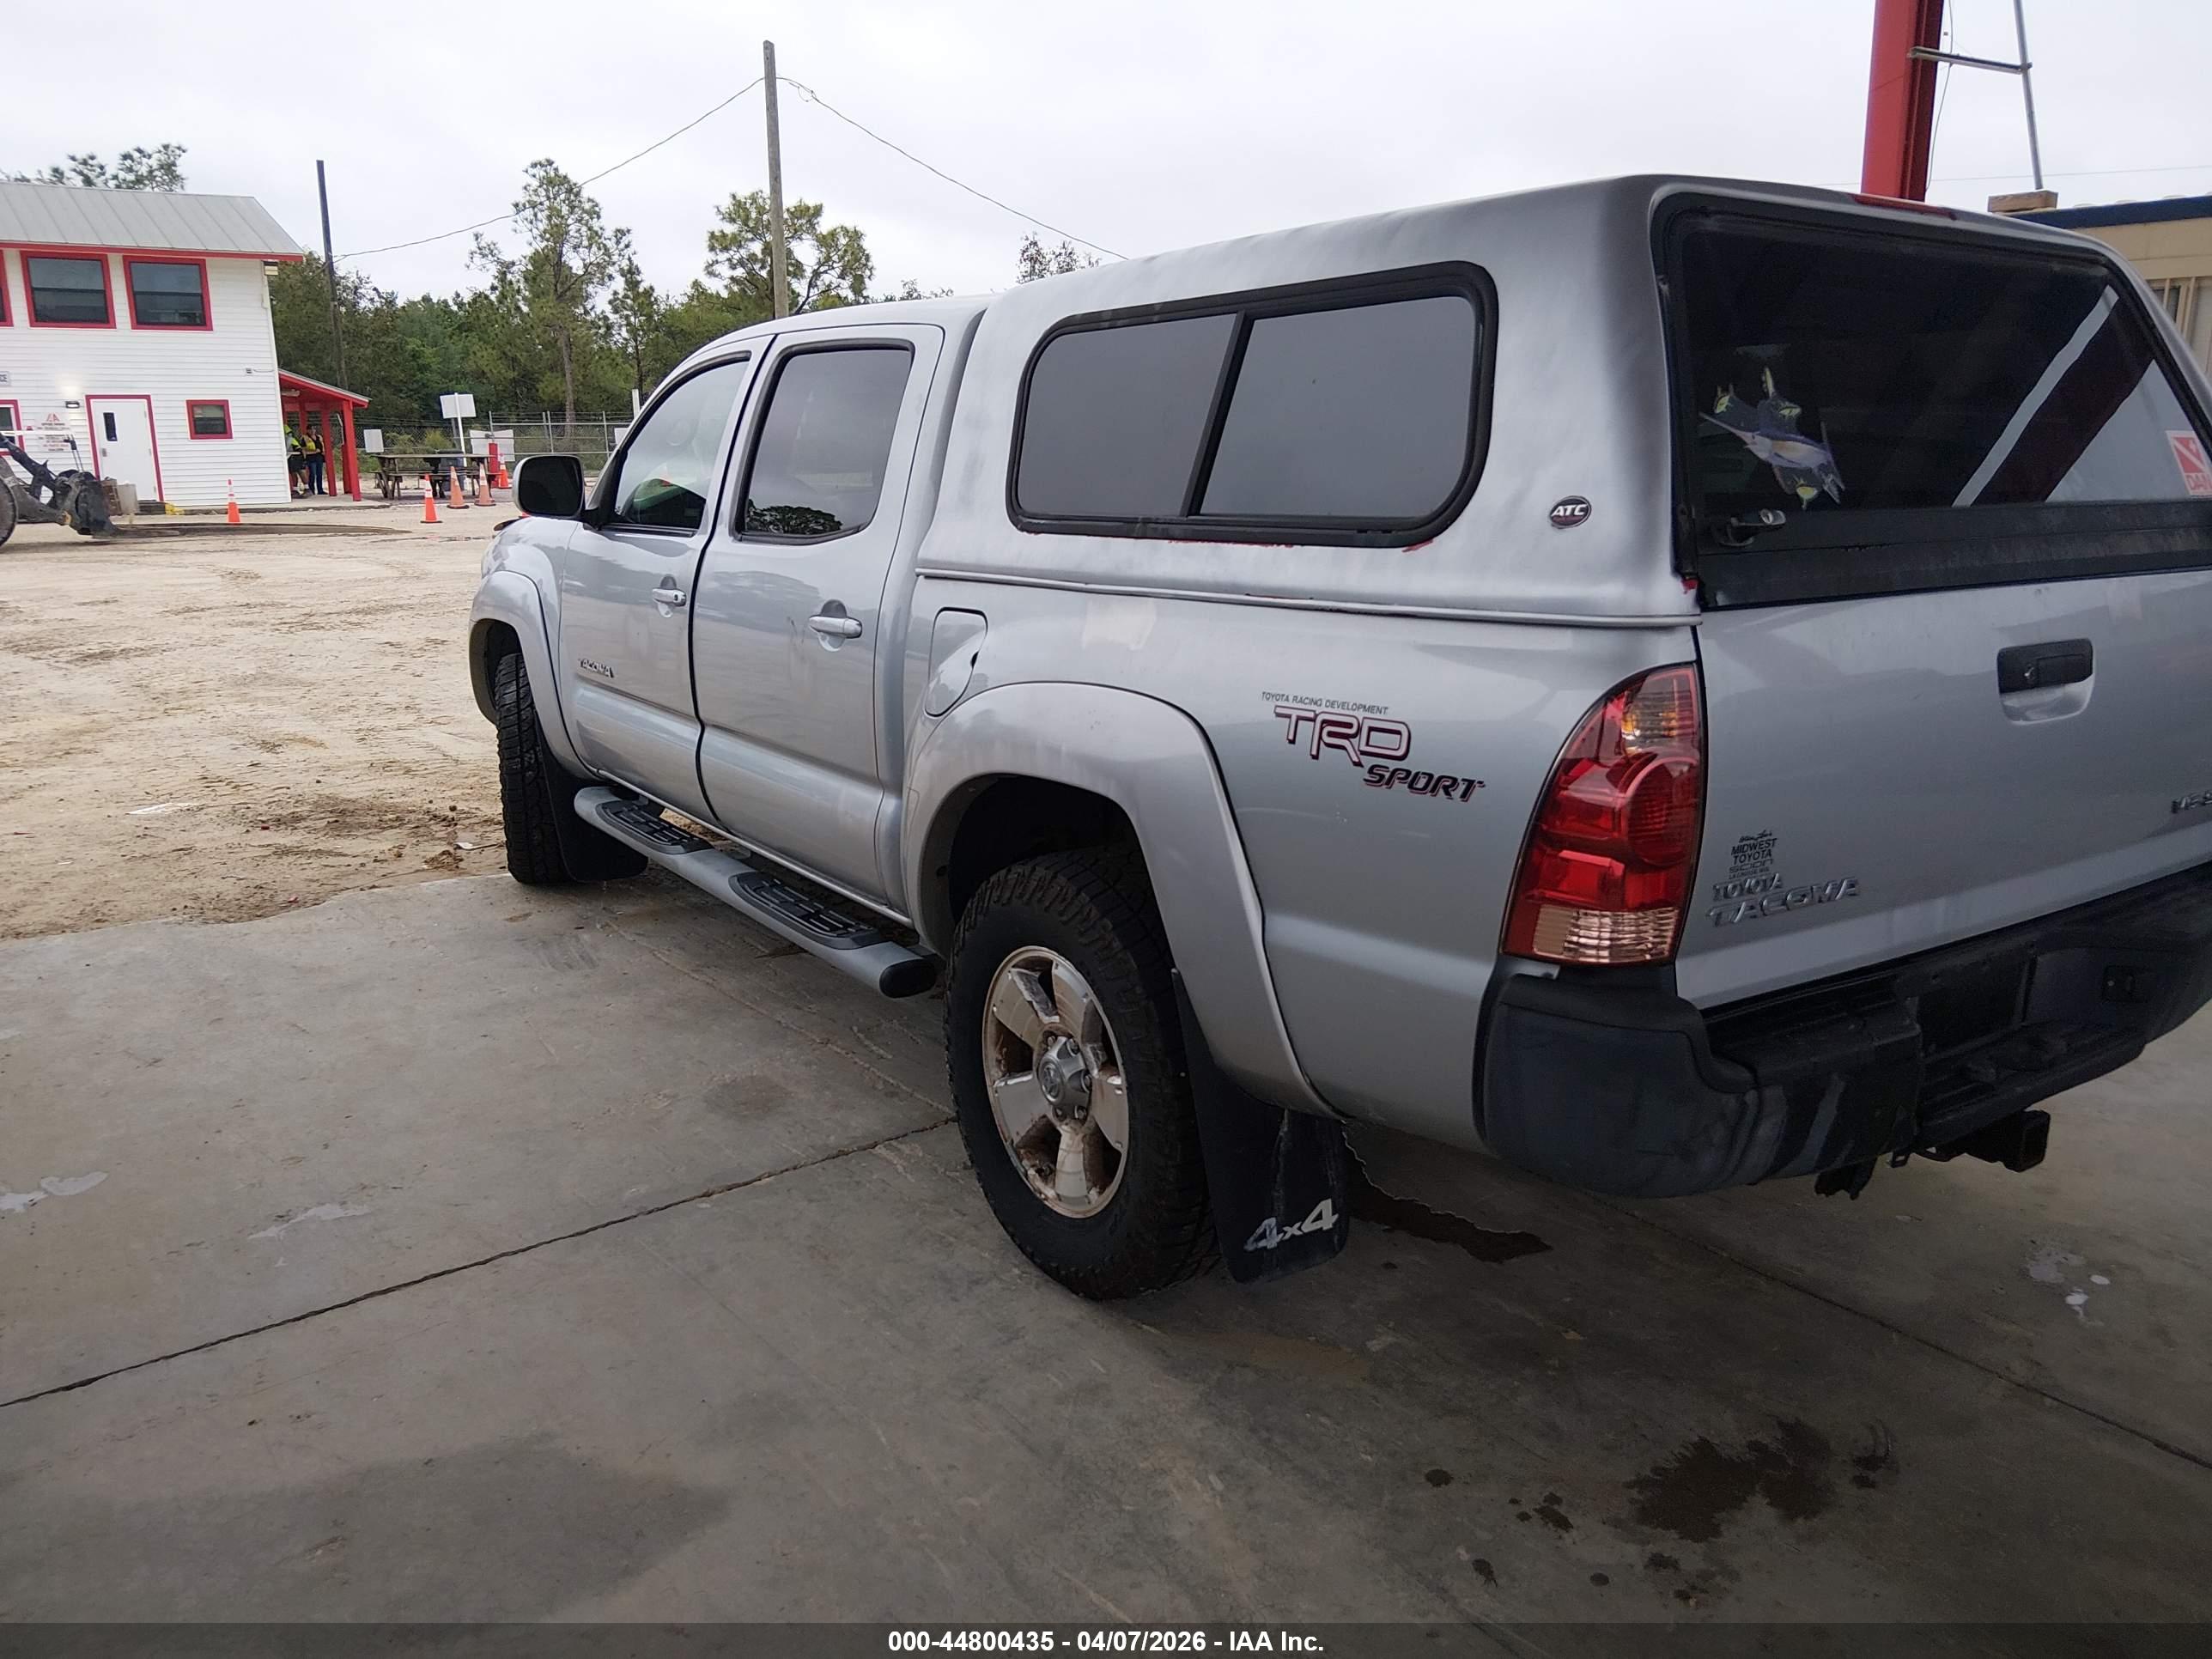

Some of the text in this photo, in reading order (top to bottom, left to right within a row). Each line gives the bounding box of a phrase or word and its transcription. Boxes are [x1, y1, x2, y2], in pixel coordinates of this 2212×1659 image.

[1550, 503, 1588, 517] ATC
[1261, 691, 1389, 715] TOYOTA RACING DEVELOPMENT
[1273, 705, 1413, 768] TRD
[1363, 764, 1486, 802] SPORT
[1730, 837, 1778, 856] MIDWEST
[1733, 848, 1771, 865] TOYOTA
[1706, 877, 1860, 927] TACOMA
[1712, 872, 1784, 902] TOYOTA
[1244, 1199, 1340, 1254] 4x4
